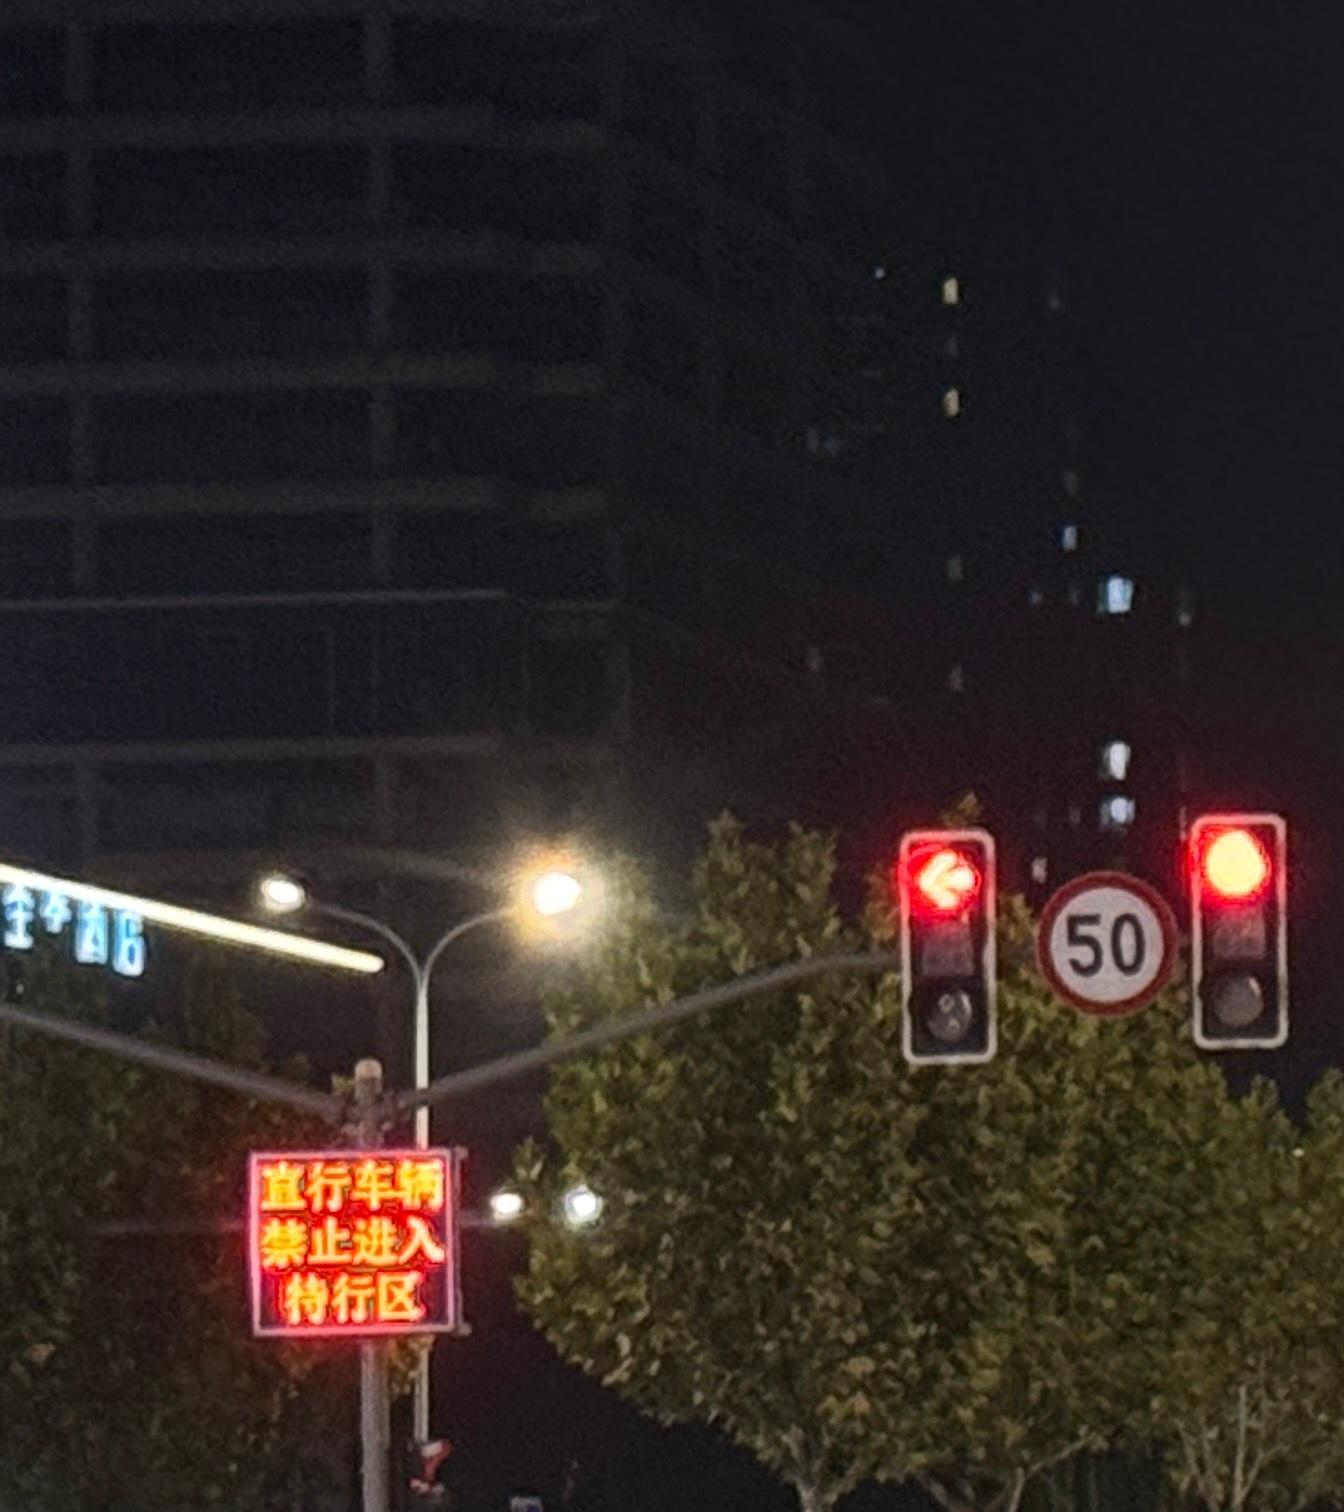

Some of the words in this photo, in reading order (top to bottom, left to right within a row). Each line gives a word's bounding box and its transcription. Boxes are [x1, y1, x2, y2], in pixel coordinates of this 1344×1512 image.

[1066, 912, 1147, 978] 50
[261, 1160, 444, 1212] 直行车辆
[261, 1215, 445, 1269] 禁止进入
